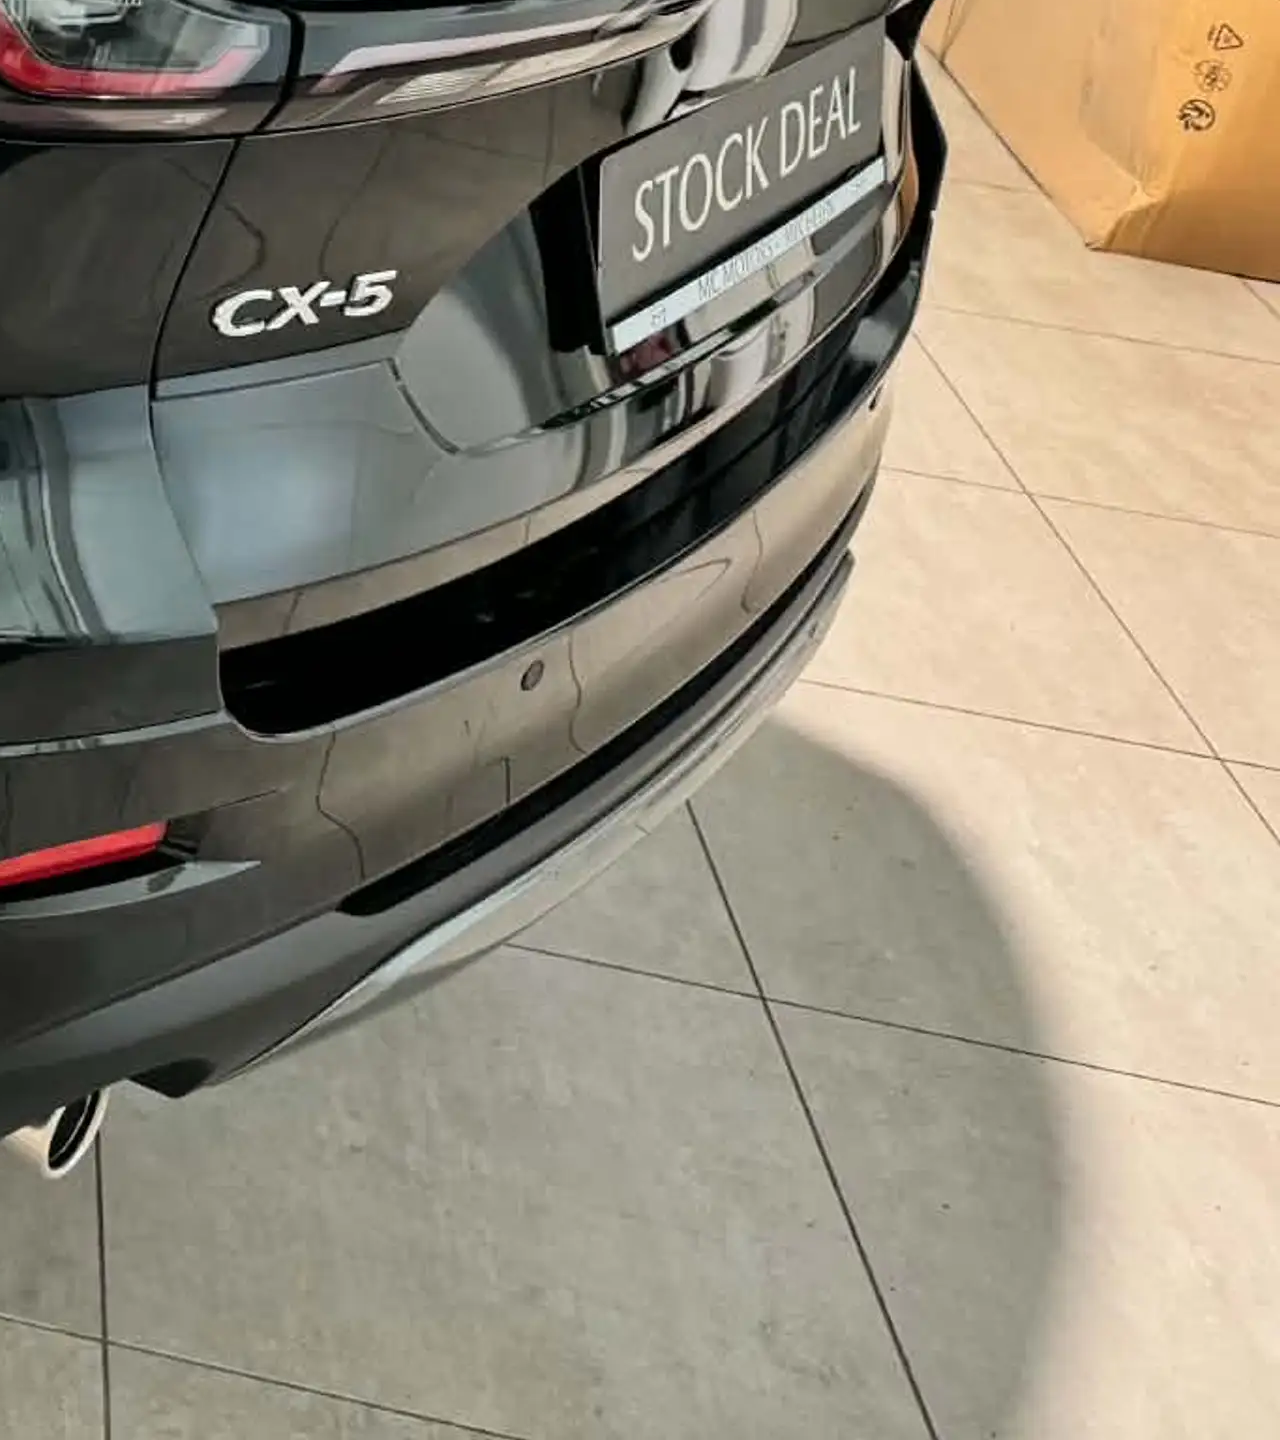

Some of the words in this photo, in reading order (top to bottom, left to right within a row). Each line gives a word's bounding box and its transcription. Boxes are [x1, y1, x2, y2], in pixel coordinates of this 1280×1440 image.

[632, 116, 770, 262] STOCK
[780, 65, 862, 179] DEAL
[213, 269, 398, 337] CX-5
